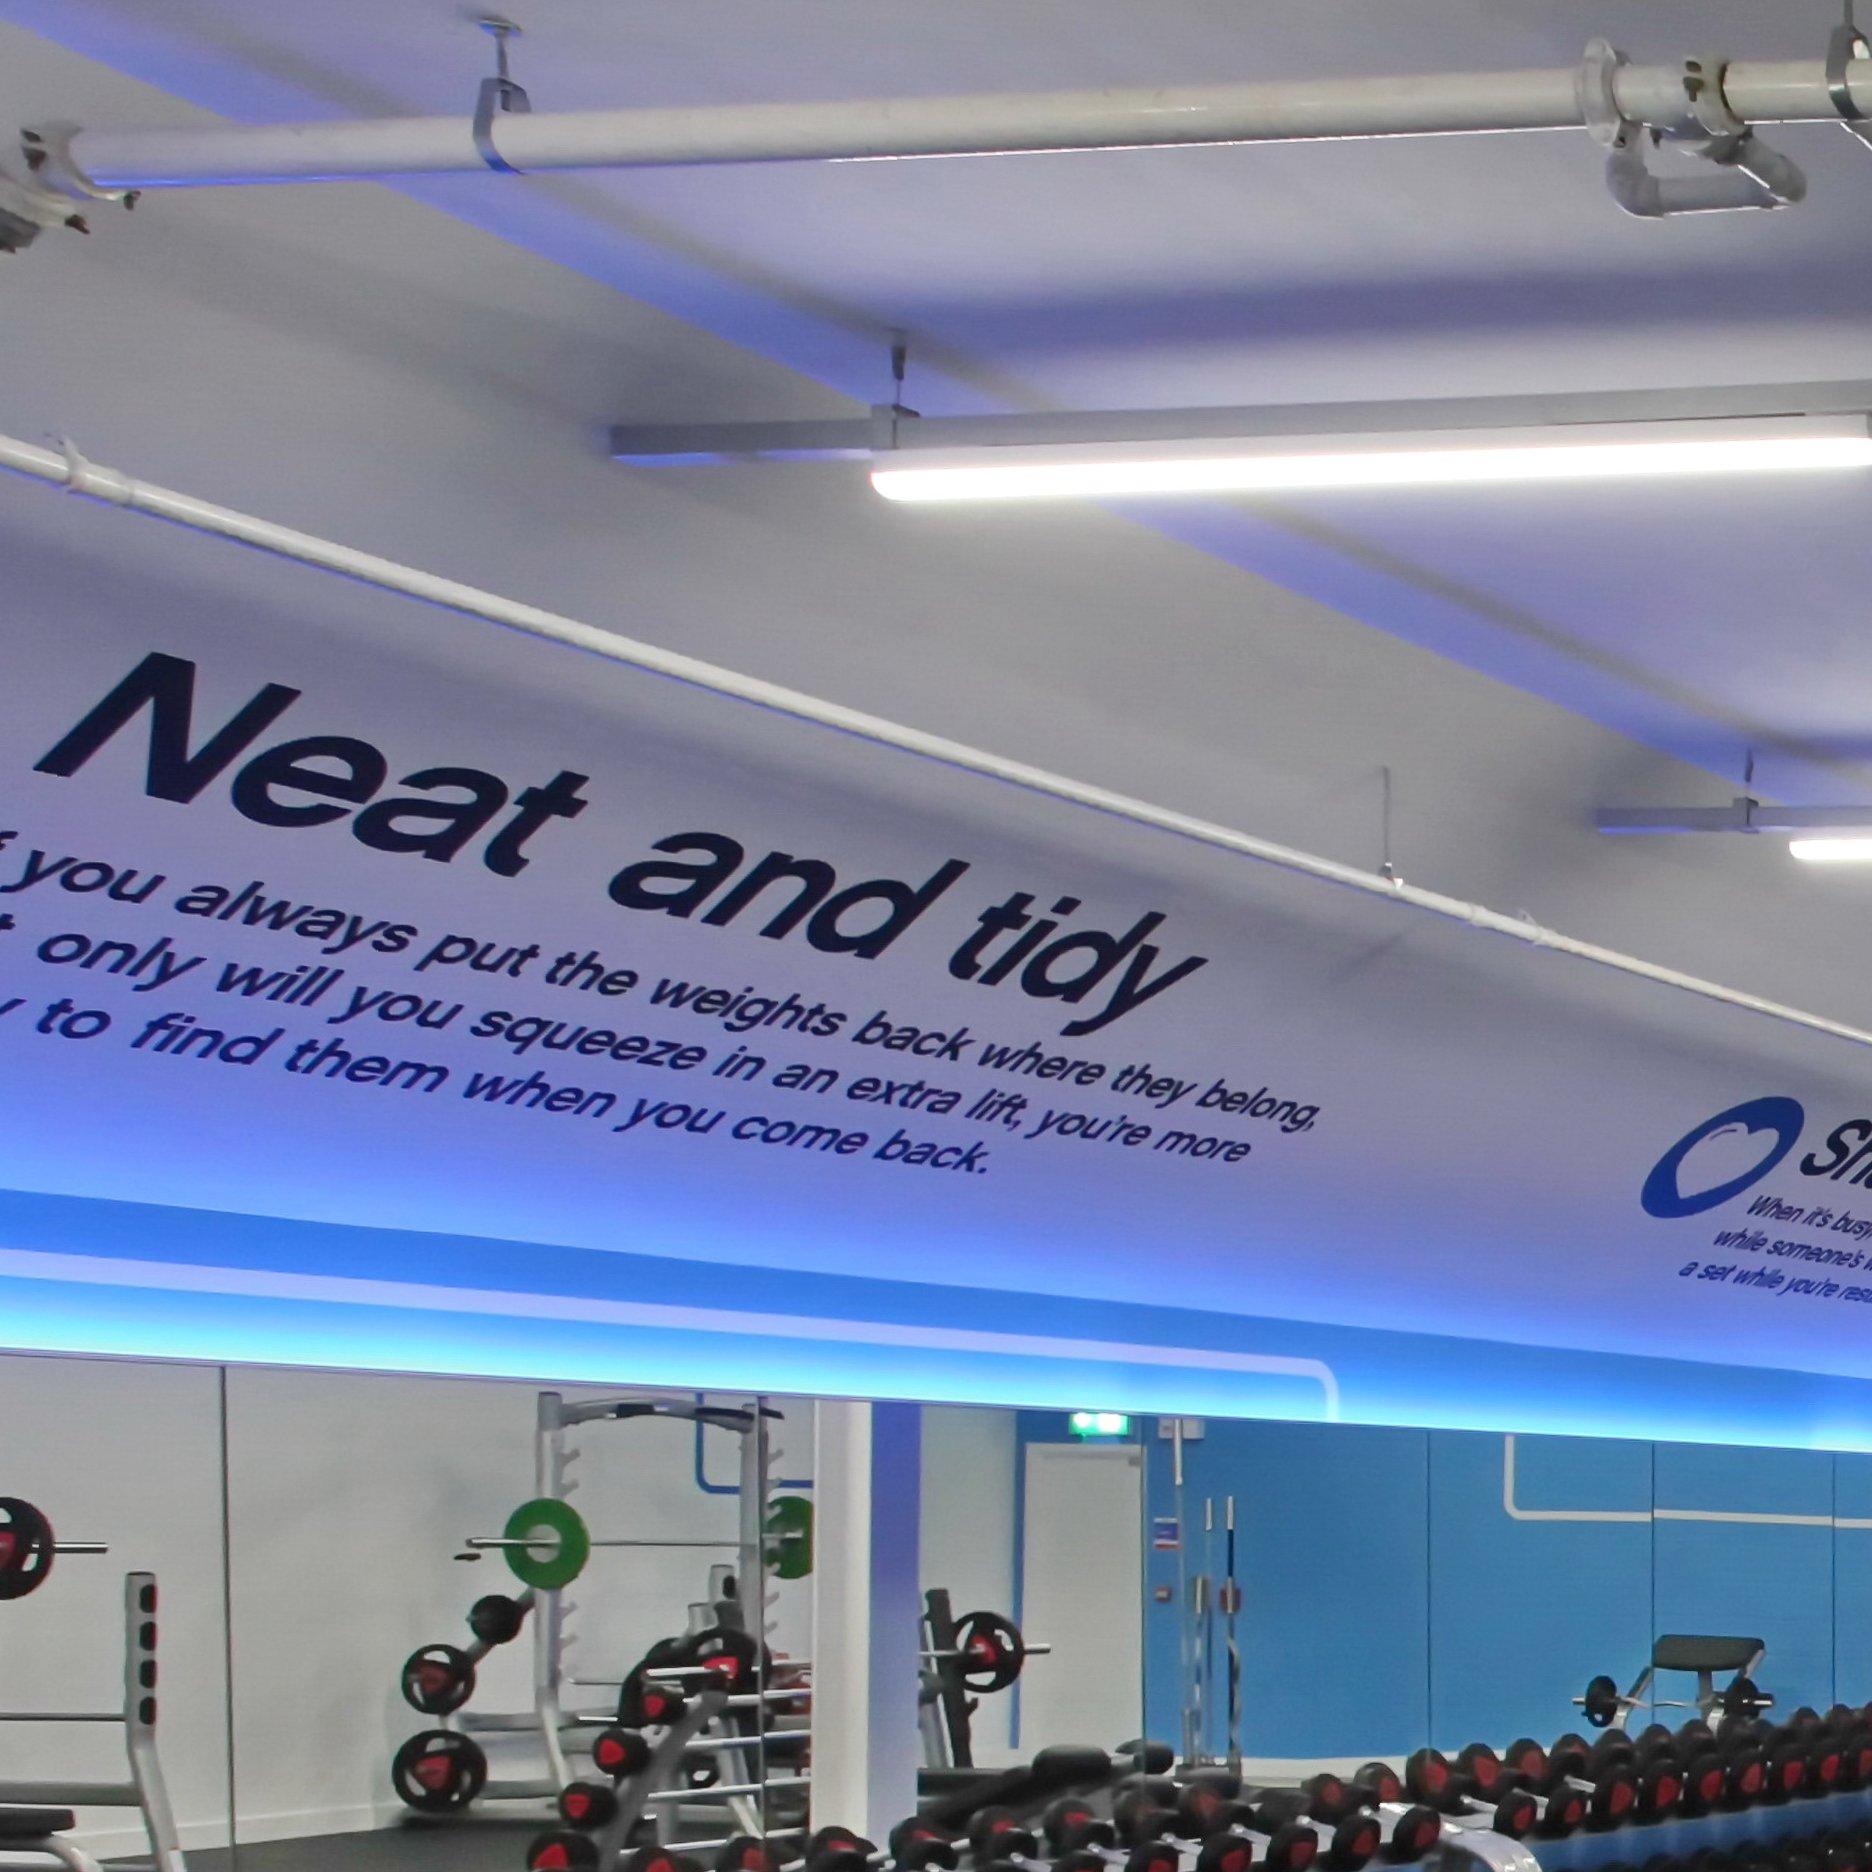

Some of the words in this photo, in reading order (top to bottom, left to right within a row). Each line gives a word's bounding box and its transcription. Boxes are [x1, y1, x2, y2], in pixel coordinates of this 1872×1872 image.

[32, 651, 592, 877] Neat
[608, 830, 971, 961] and
[948, 890, 1209, 1036] tidy
[1, 849, 166, 903] you
[174, 881, 418, 955] always
[413, 934, 540, 978] put
[545, 951, 639, 997] the
[650, 978, 848, 1036] weights
[851, 1010, 975, 1063] back
[978, 1041, 1106, 1086] where
[1110, 1063, 1198, 1109] they
[1196, 1078, 1321, 1134] belong,
[37, 933, 207, 992] only
[216, 963, 345, 1006] will
[327, 985, 465, 1029] you
[469, 1008, 708, 1070] squeeze
[712, 1046, 767, 1082] in
[772, 1063, 839, 1094] an
[846, 1076, 962, 1114] extra
[965, 1088, 1029, 1132] lift,
[1024, 1109, 1153, 1146] you're
[1154, 1130, 1252, 1163] more
[36, 999, 111, 1039] to
[131, 1012, 286, 1065] find
[284, 1037, 450, 1092] them
[462, 1071, 617, 1118] when
[612, 1097, 727, 1134] you
[731, 1115, 869, 1154] come
[873, 1129, 990, 1175] back.
[1678, 1261, 1700, 1277] a
[1697, 1264, 1737, 1282] set
[1732, 1265, 1785, 1289] while
[1713, 1227, 1768, 1251] while
[1747, 1195, 1804, 1222] When
